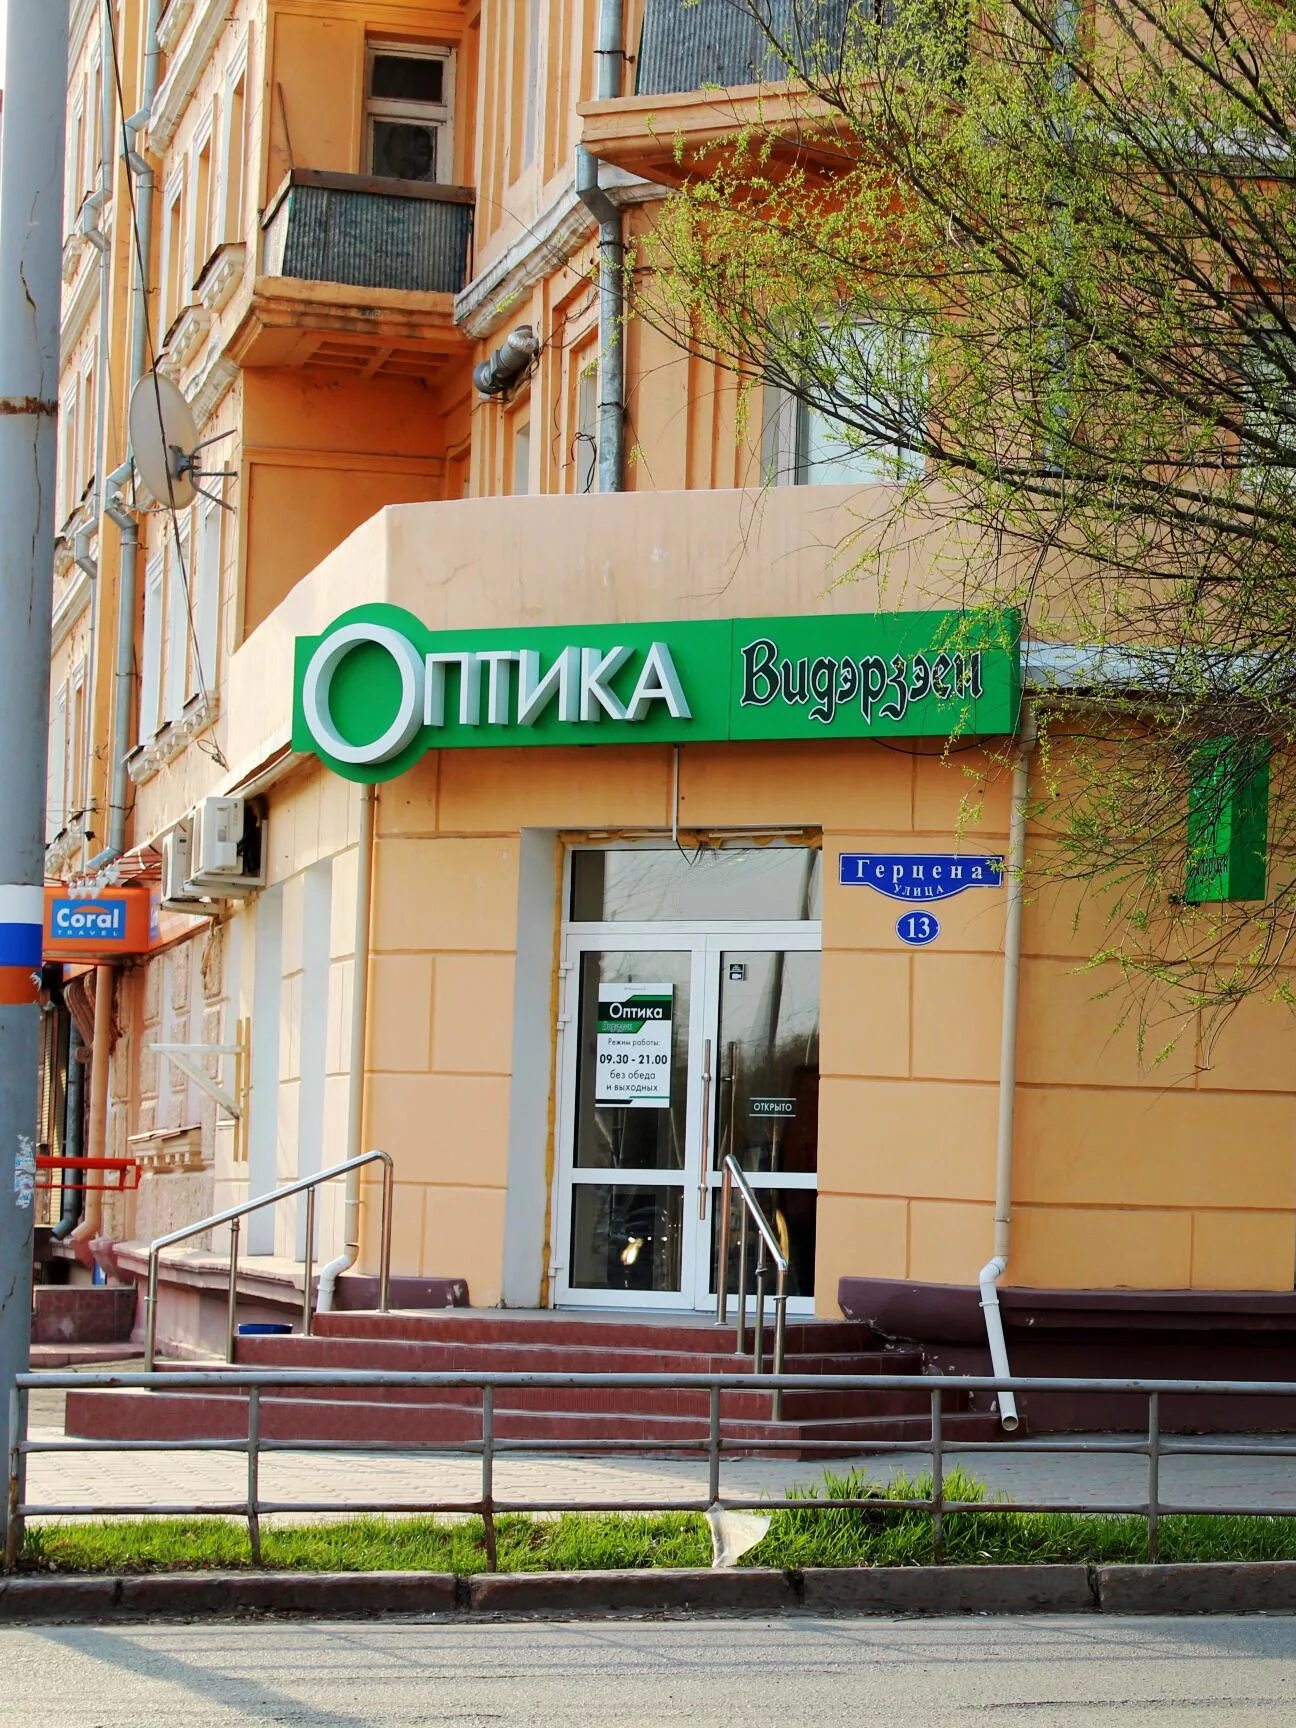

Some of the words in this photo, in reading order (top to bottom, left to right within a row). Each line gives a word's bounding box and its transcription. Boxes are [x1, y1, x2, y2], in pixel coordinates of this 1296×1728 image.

[303, 622, 692, 764] ОПТИКА
[856, 859, 983, 883] Герцена
[56, 908, 119, 929] Coral
[57, 929, 119, 937] TRAVEL
[907, 917, 931, 939] 13
[609, 1002, 663, 1019] Оптика
[632, 1038, 661, 1047] работы:
[599, 1053, 629, 1065] 09.30
[638, 1054, 668, 1065] 21.00
[609, 1069, 626, 1079] без
[628, 1069, 656, 1080] обеда
[614, 1084, 658, 1092] выходных
[753, 1102, 792, 1112] ОТКРЫТО
